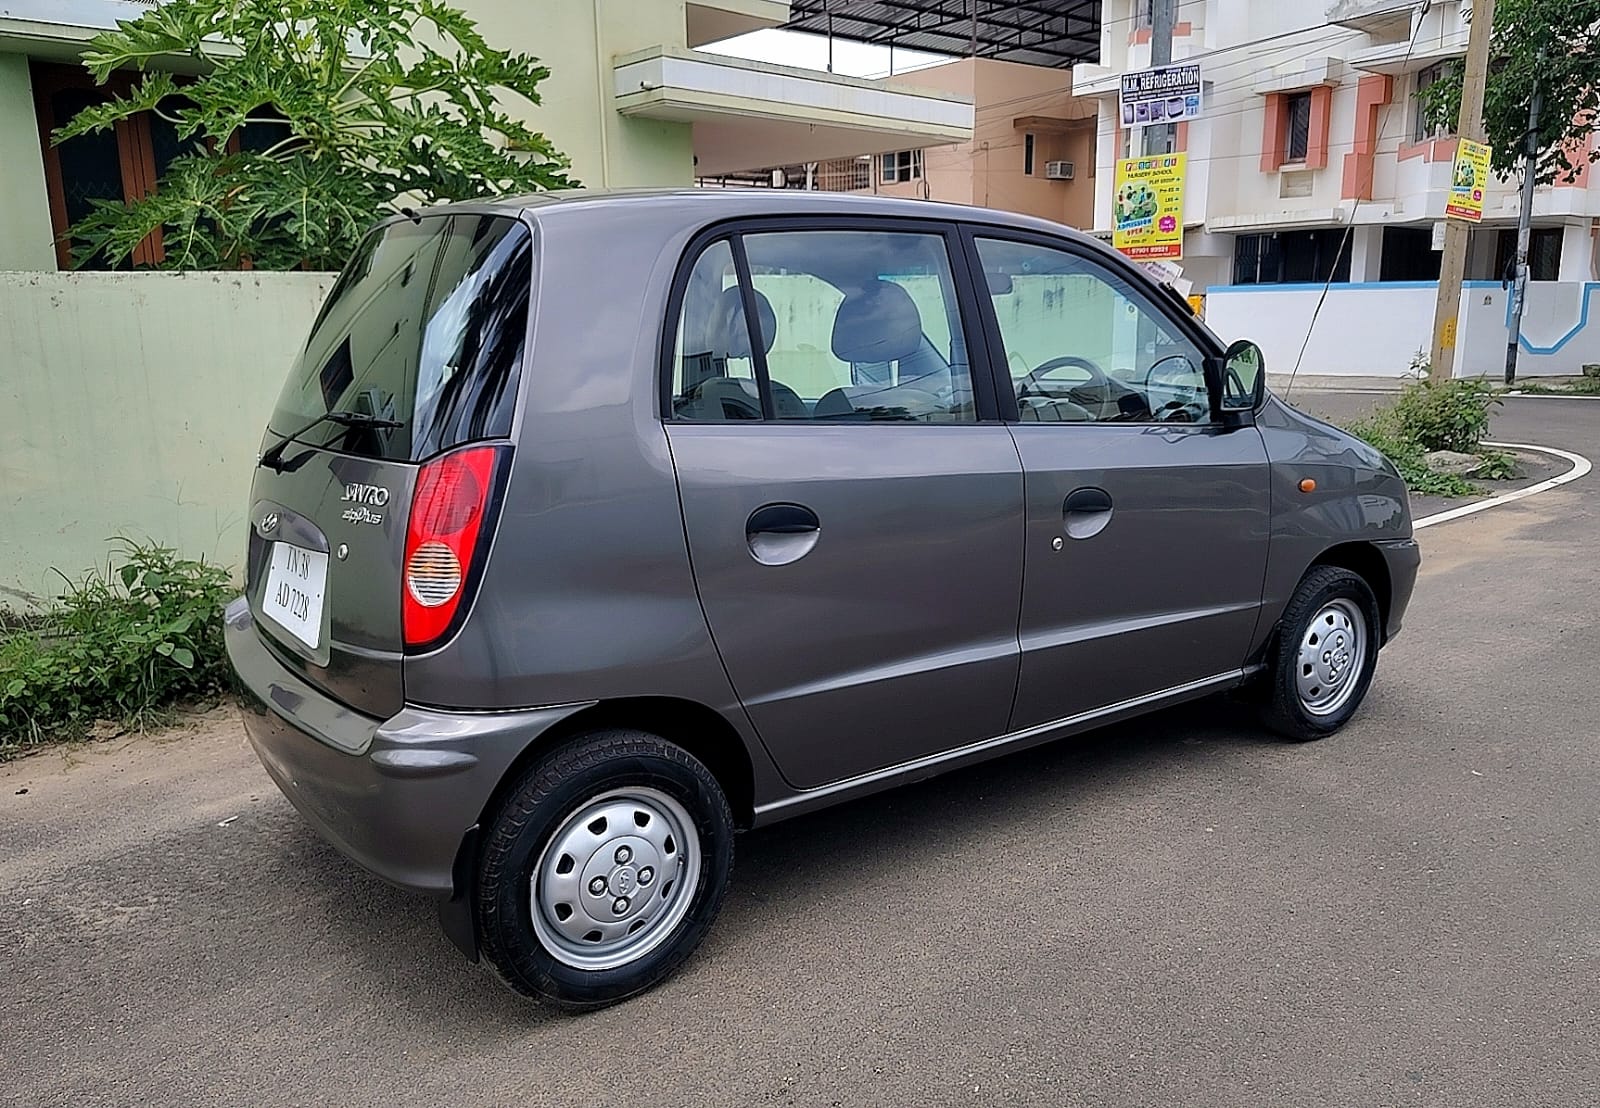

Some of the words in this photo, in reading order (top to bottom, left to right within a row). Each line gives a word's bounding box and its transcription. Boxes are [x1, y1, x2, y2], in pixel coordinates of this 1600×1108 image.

[1140, 70, 1199, 91] REFRIGERATION
[1127, 171, 1151, 179] NURSERY
[1152, 169, 1173, 177] SCHOOL
[1117, 218, 1152, 231] ADMISSION
[1126, 227, 1143, 237] OPEN
[286, 545, 299, 573] TN
[299, 552, 311, 580] 38
[275, 580, 290, 608] AD
[290, 588, 310, 622] 7228
